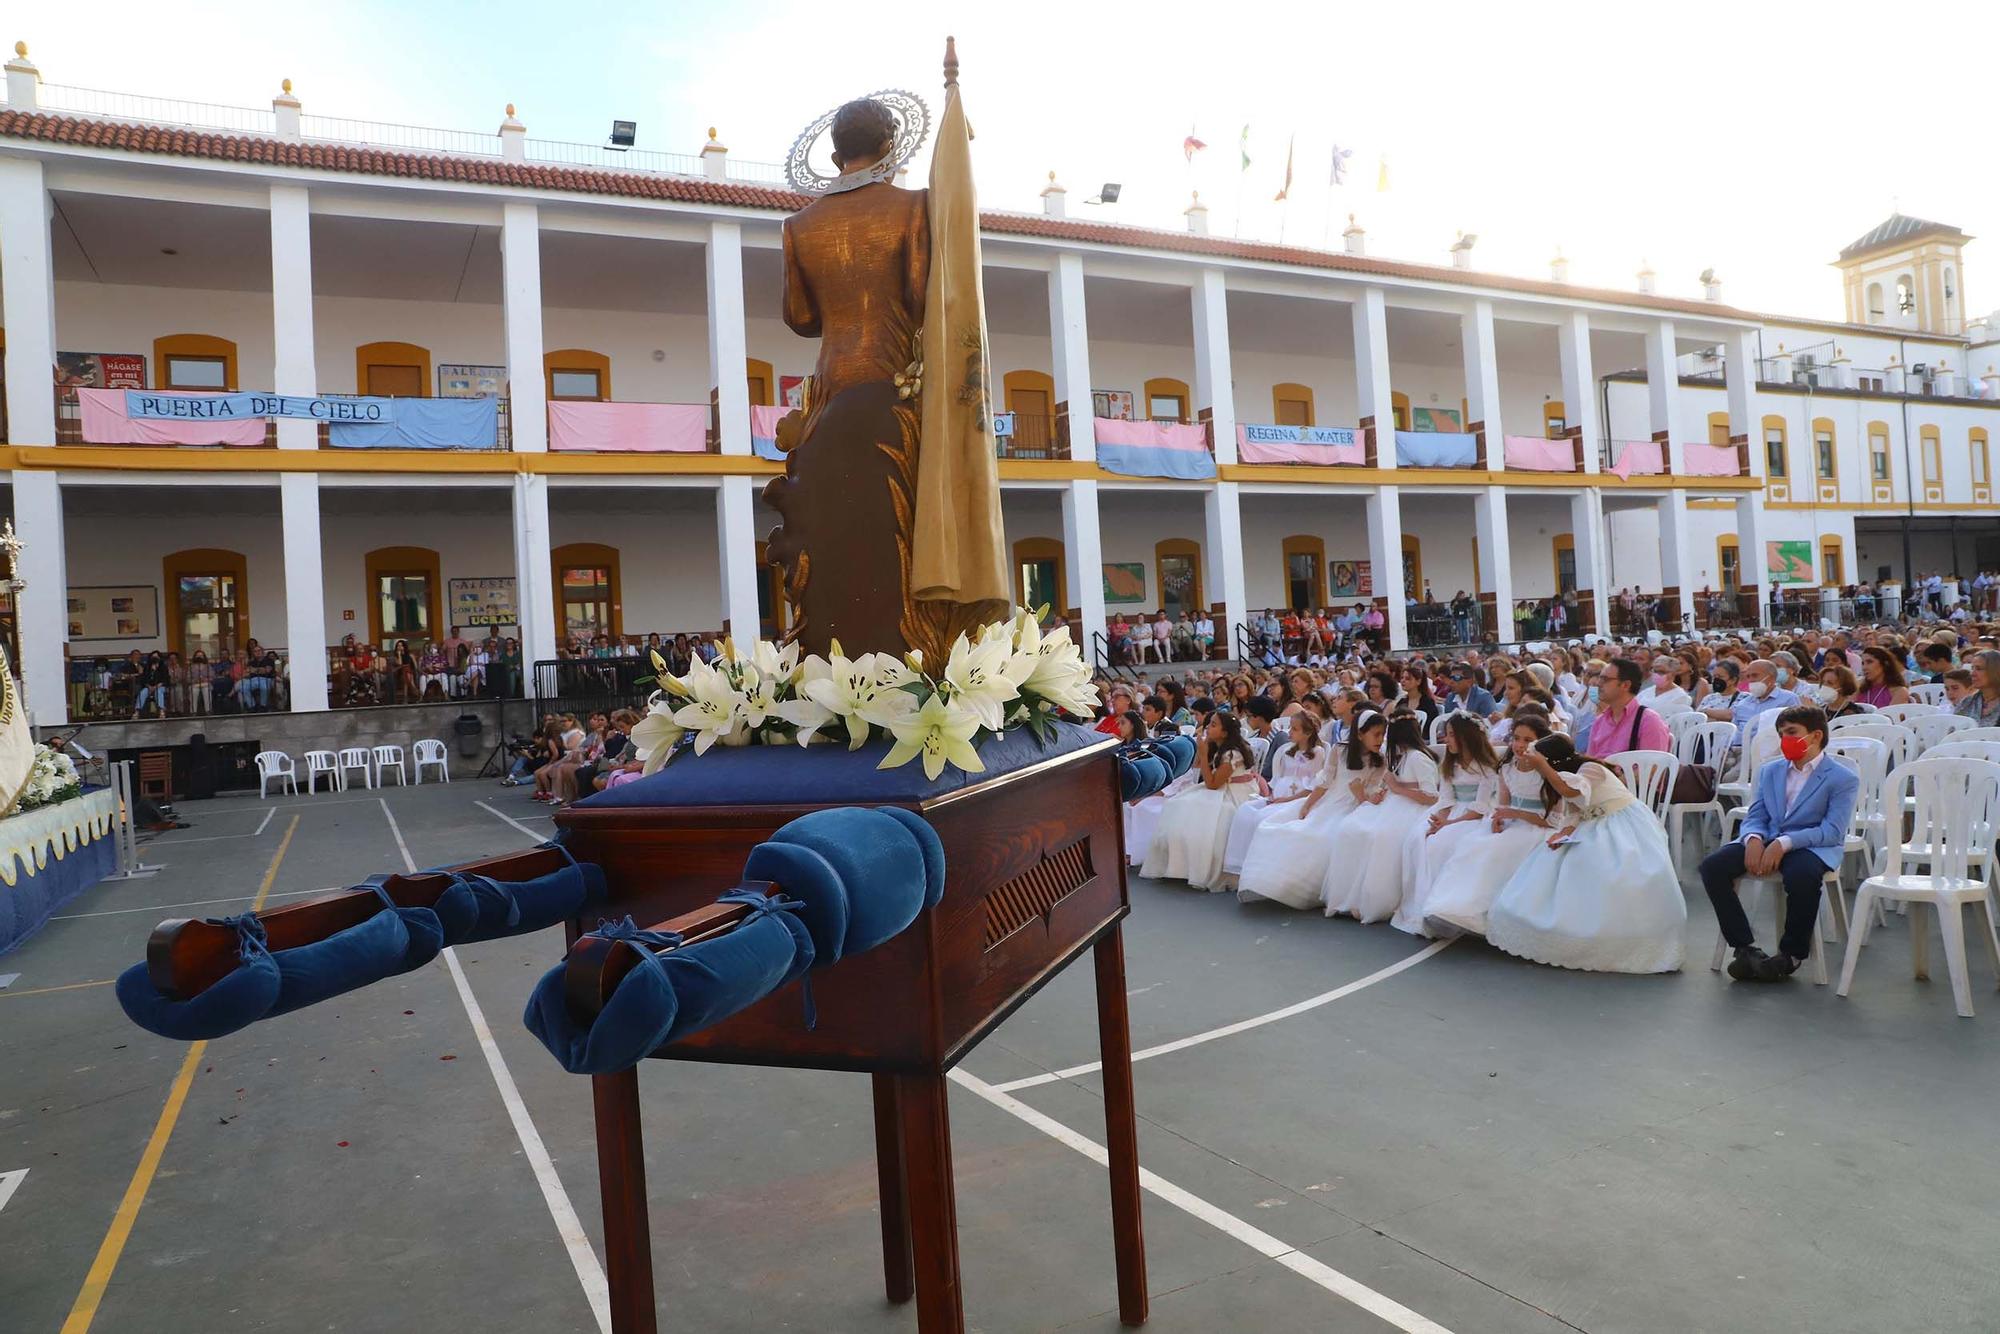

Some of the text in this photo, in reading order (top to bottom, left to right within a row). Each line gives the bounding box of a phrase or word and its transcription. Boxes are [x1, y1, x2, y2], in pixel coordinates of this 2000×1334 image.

[141, 397, 381, 421] PUERTA DEL CIELO
[1247, 426, 1354, 444] REGINA MATER
